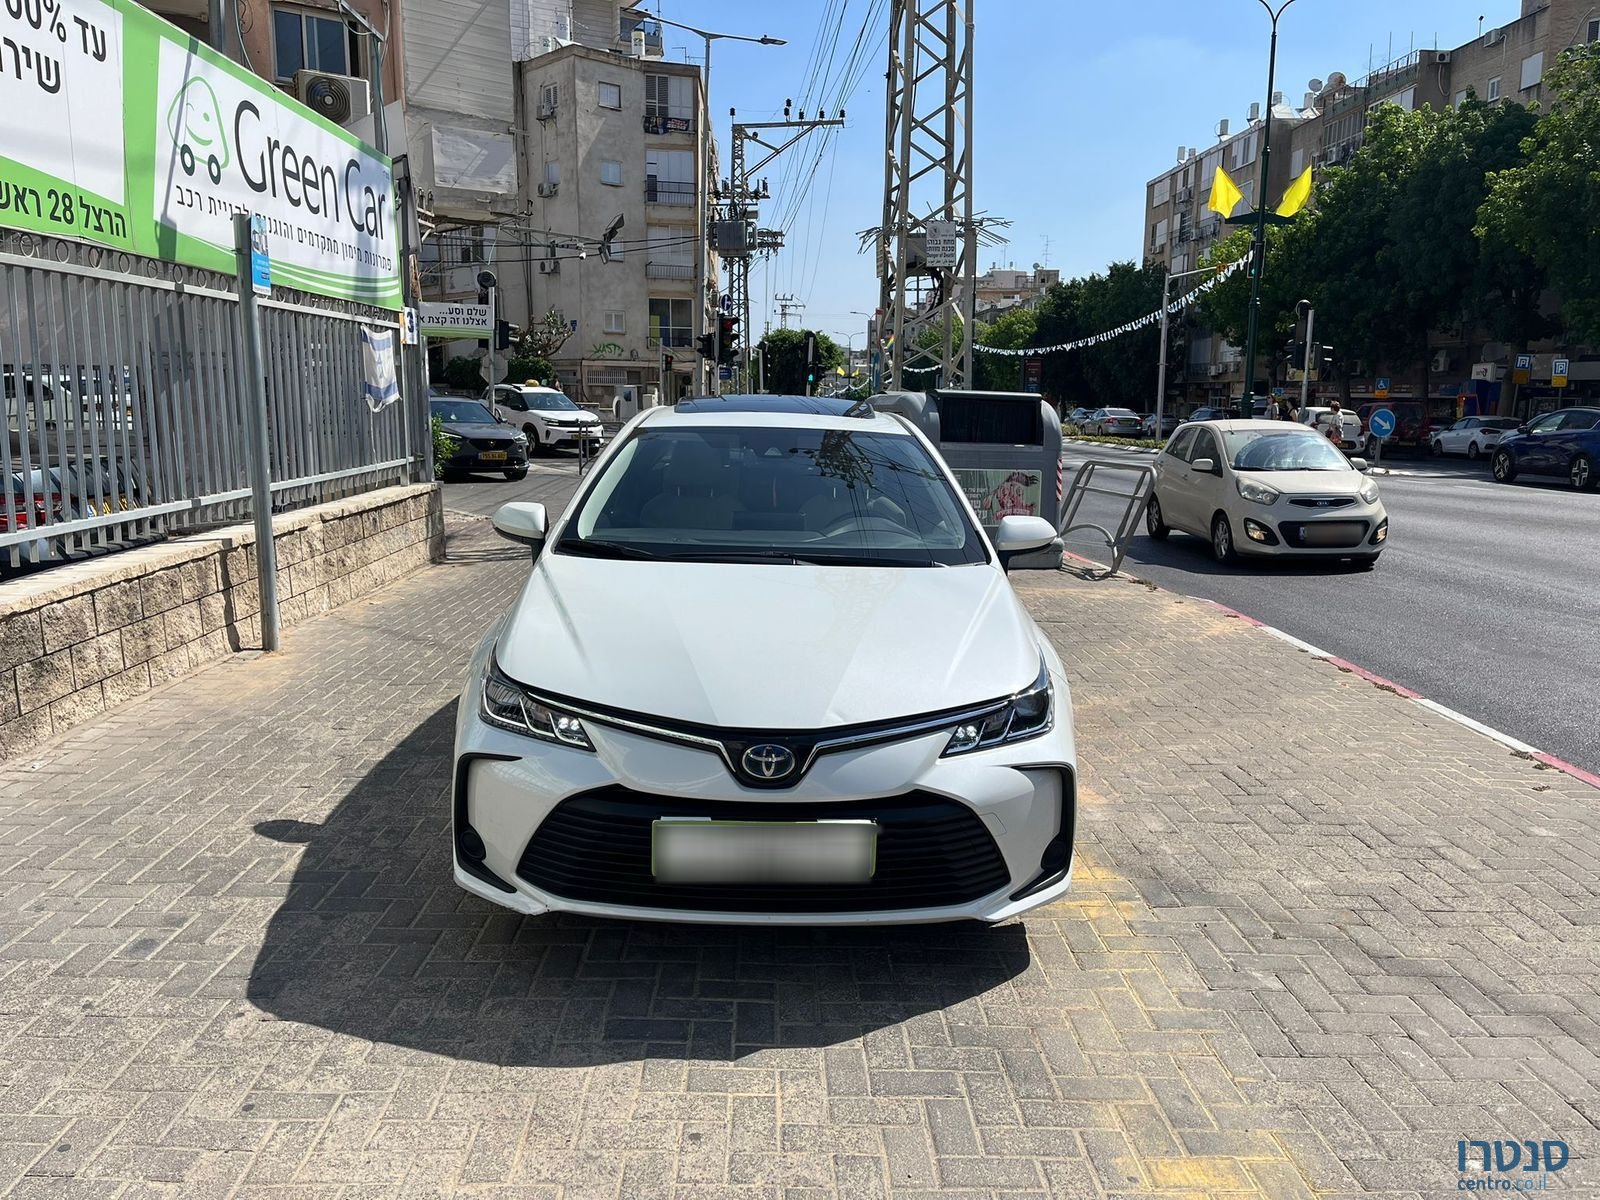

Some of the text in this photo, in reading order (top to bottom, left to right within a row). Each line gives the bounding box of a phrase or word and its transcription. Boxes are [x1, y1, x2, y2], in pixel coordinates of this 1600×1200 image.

[73, 14, 106, 62] עד
[0, 36, 60, 94] שיר
[234, 99, 385, 240] Green Car
[47, 188, 74, 225] 28
[176, 185, 202, 211] רכב
[79, 195, 127, 238] הרצל
[297, 227, 339, 254] מתקדמים
[428, 316, 447, 326] קצת
[439, 307, 487, 316] שלם וסע...
[450, 317, 460, 325] זה
[463, 316, 487, 326] אצלנו
